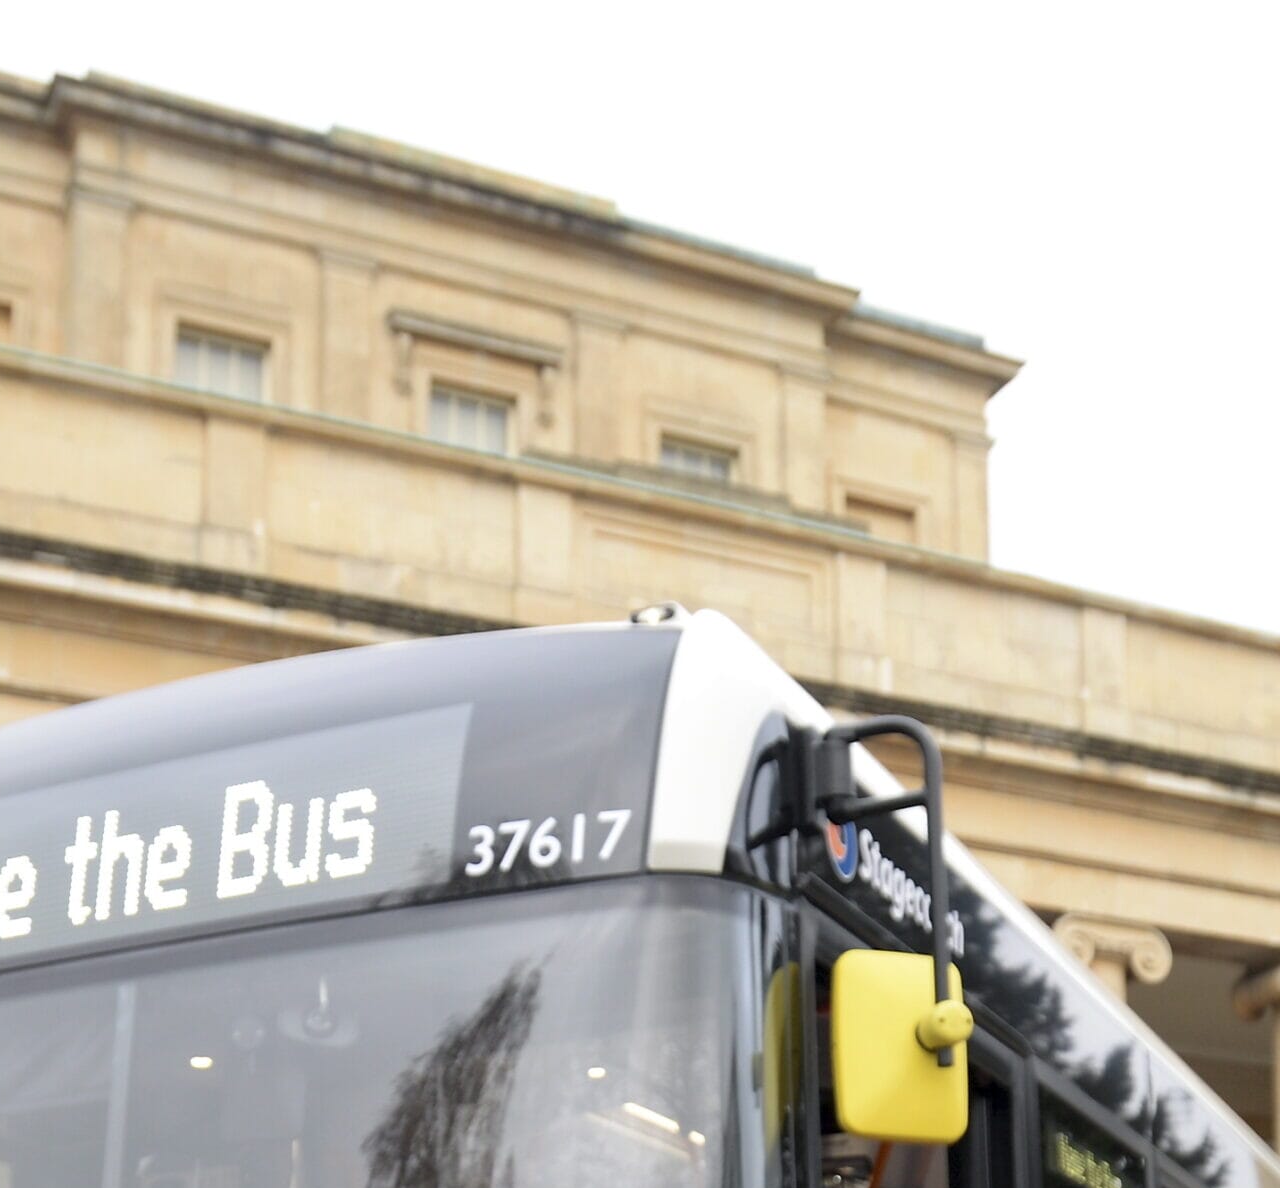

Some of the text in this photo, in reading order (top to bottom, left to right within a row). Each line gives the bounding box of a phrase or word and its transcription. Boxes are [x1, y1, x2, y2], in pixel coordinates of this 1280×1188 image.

[63, 808, 193, 926] the
[215, 778, 378, 900] Bus
[464, 808, 634, 877] 37617
[858, 828, 965, 959] Stagecoch
